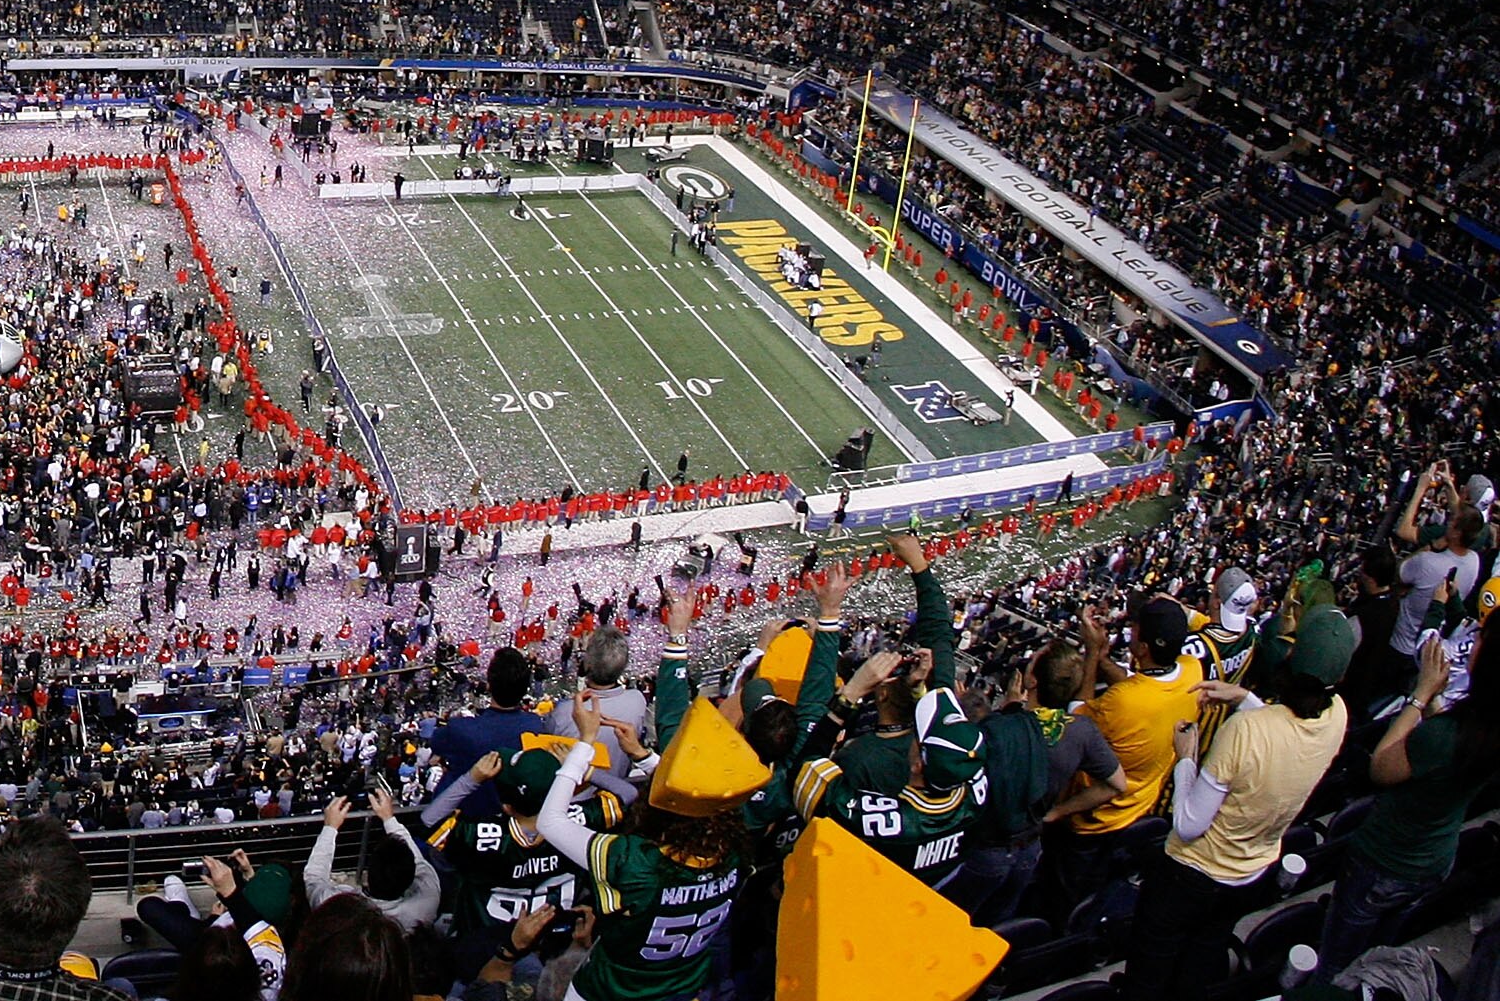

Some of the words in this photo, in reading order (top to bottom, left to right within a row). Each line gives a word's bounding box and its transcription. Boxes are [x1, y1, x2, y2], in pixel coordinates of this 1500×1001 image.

[501, 61, 540, 69] NATIONAL
[542, 62, 581, 70] FOOTBALL
[584, 63, 615, 71] LEAGUE
[916, 114, 1003, 173] NATIONAL
[1001, 174, 1109, 248] FOOTBALL
[1111, 249, 1211, 315] LEAGUE
[901, 198, 953, 247] SUPER
[981, 260, 1037, 310] BOWL
[490, 389, 557, 414] 20
[654, 376, 714, 400] 10
[860, 794, 902, 837] 92
[475, 822, 503, 852] 80
[913, 830, 965, 870] WHITE
[511, 855, 560, 880] DRIVER
[660, 867, 739, 906] MATTHEWS
[639, 898, 733, 962] 52
